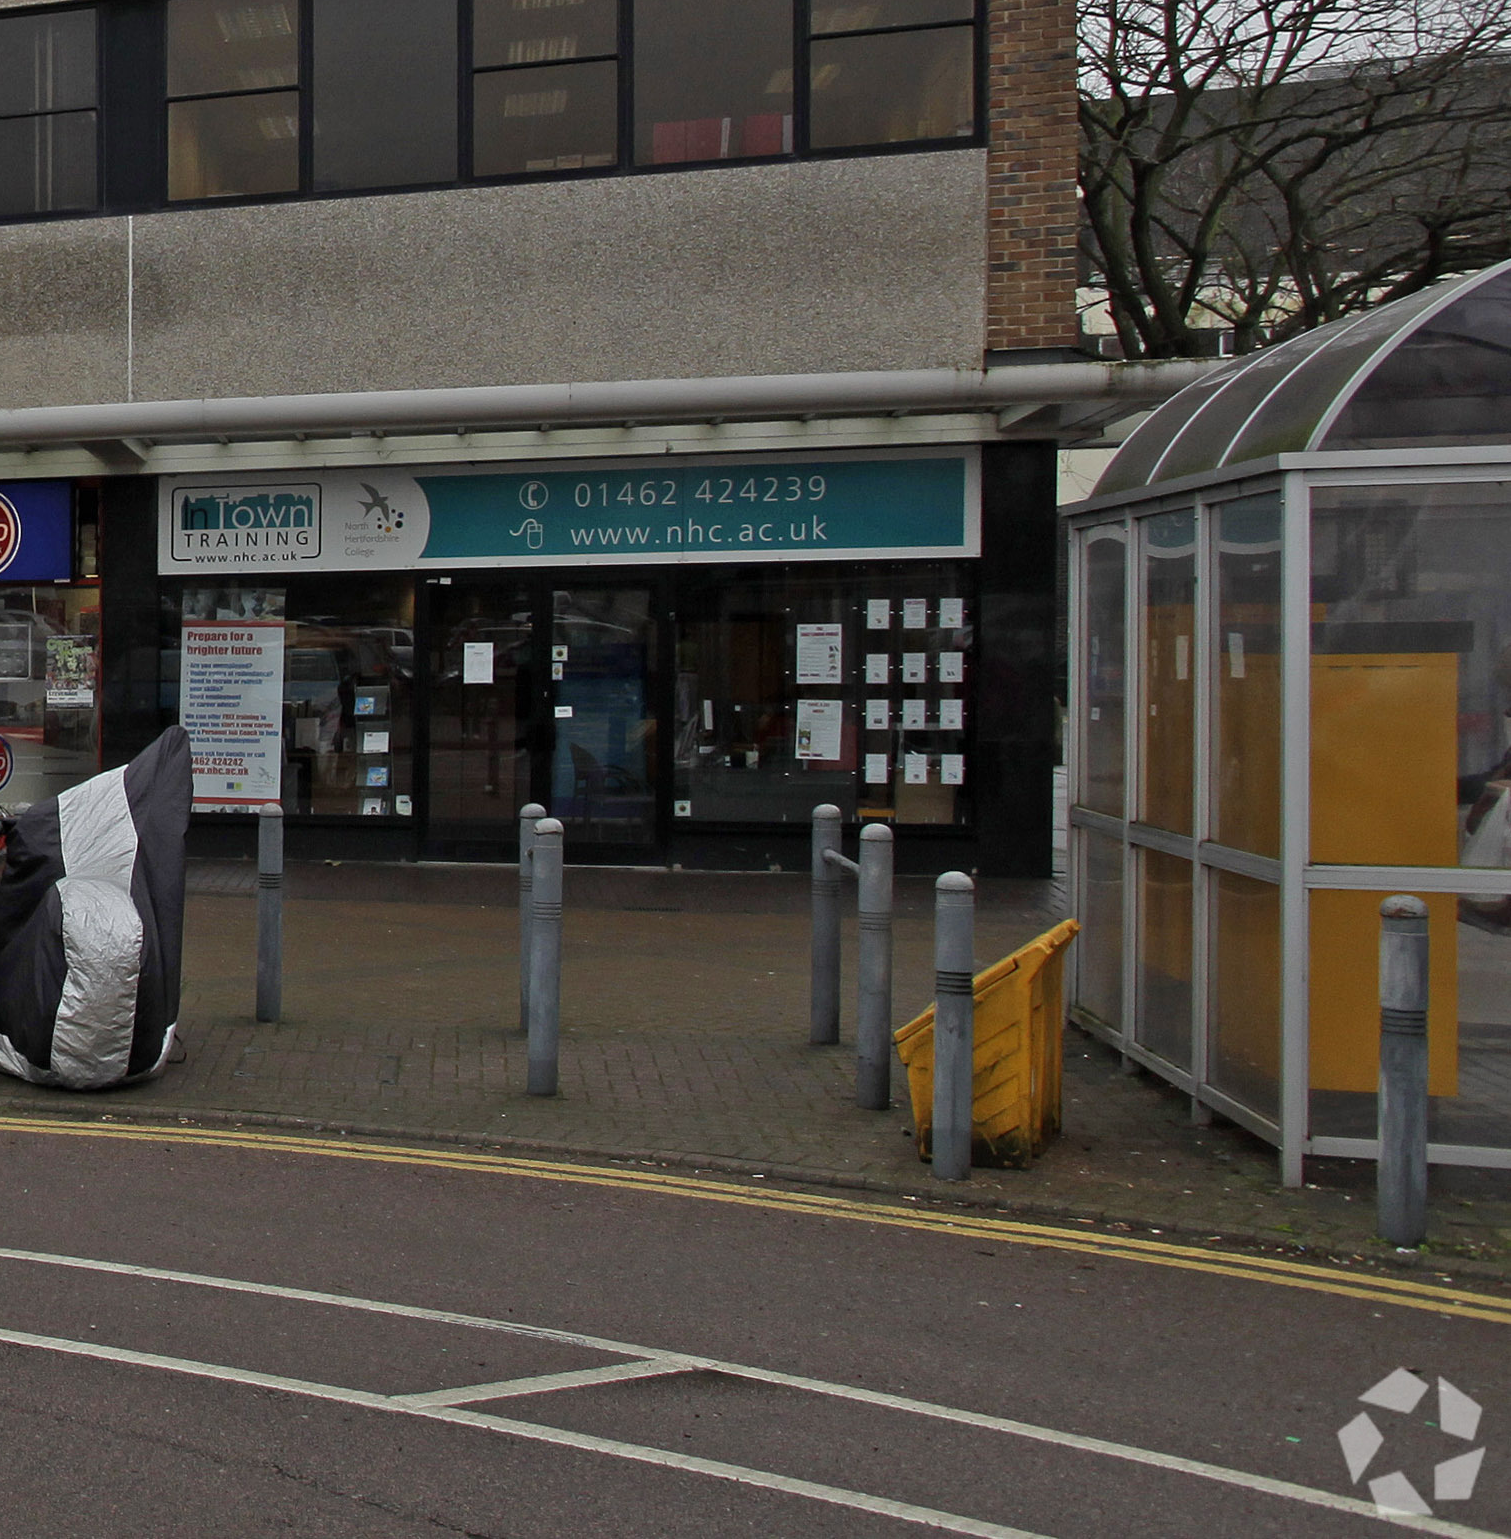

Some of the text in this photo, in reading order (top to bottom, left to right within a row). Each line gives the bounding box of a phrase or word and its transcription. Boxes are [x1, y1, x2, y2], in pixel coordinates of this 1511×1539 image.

[574, 475, 826, 507] 01462 424239
[345, 522, 369, 531] North
[570, 515, 827, 546] www.nhc.ac.uk
[184, 530, 309, 548] TRAINING
[345, 534, 400, 543] Hertfordshire
[195, 551, 298, 563] www.nhc.ac.uk
[345, 547, 375, 557] College
[187, 631, 253, 641] Prepare for a
[187, 645, 263, 656] brighter future
[191, 757, 244, 766] 1462 424242
[192, 767, 249, 776] ww.nhc.ac.uk
